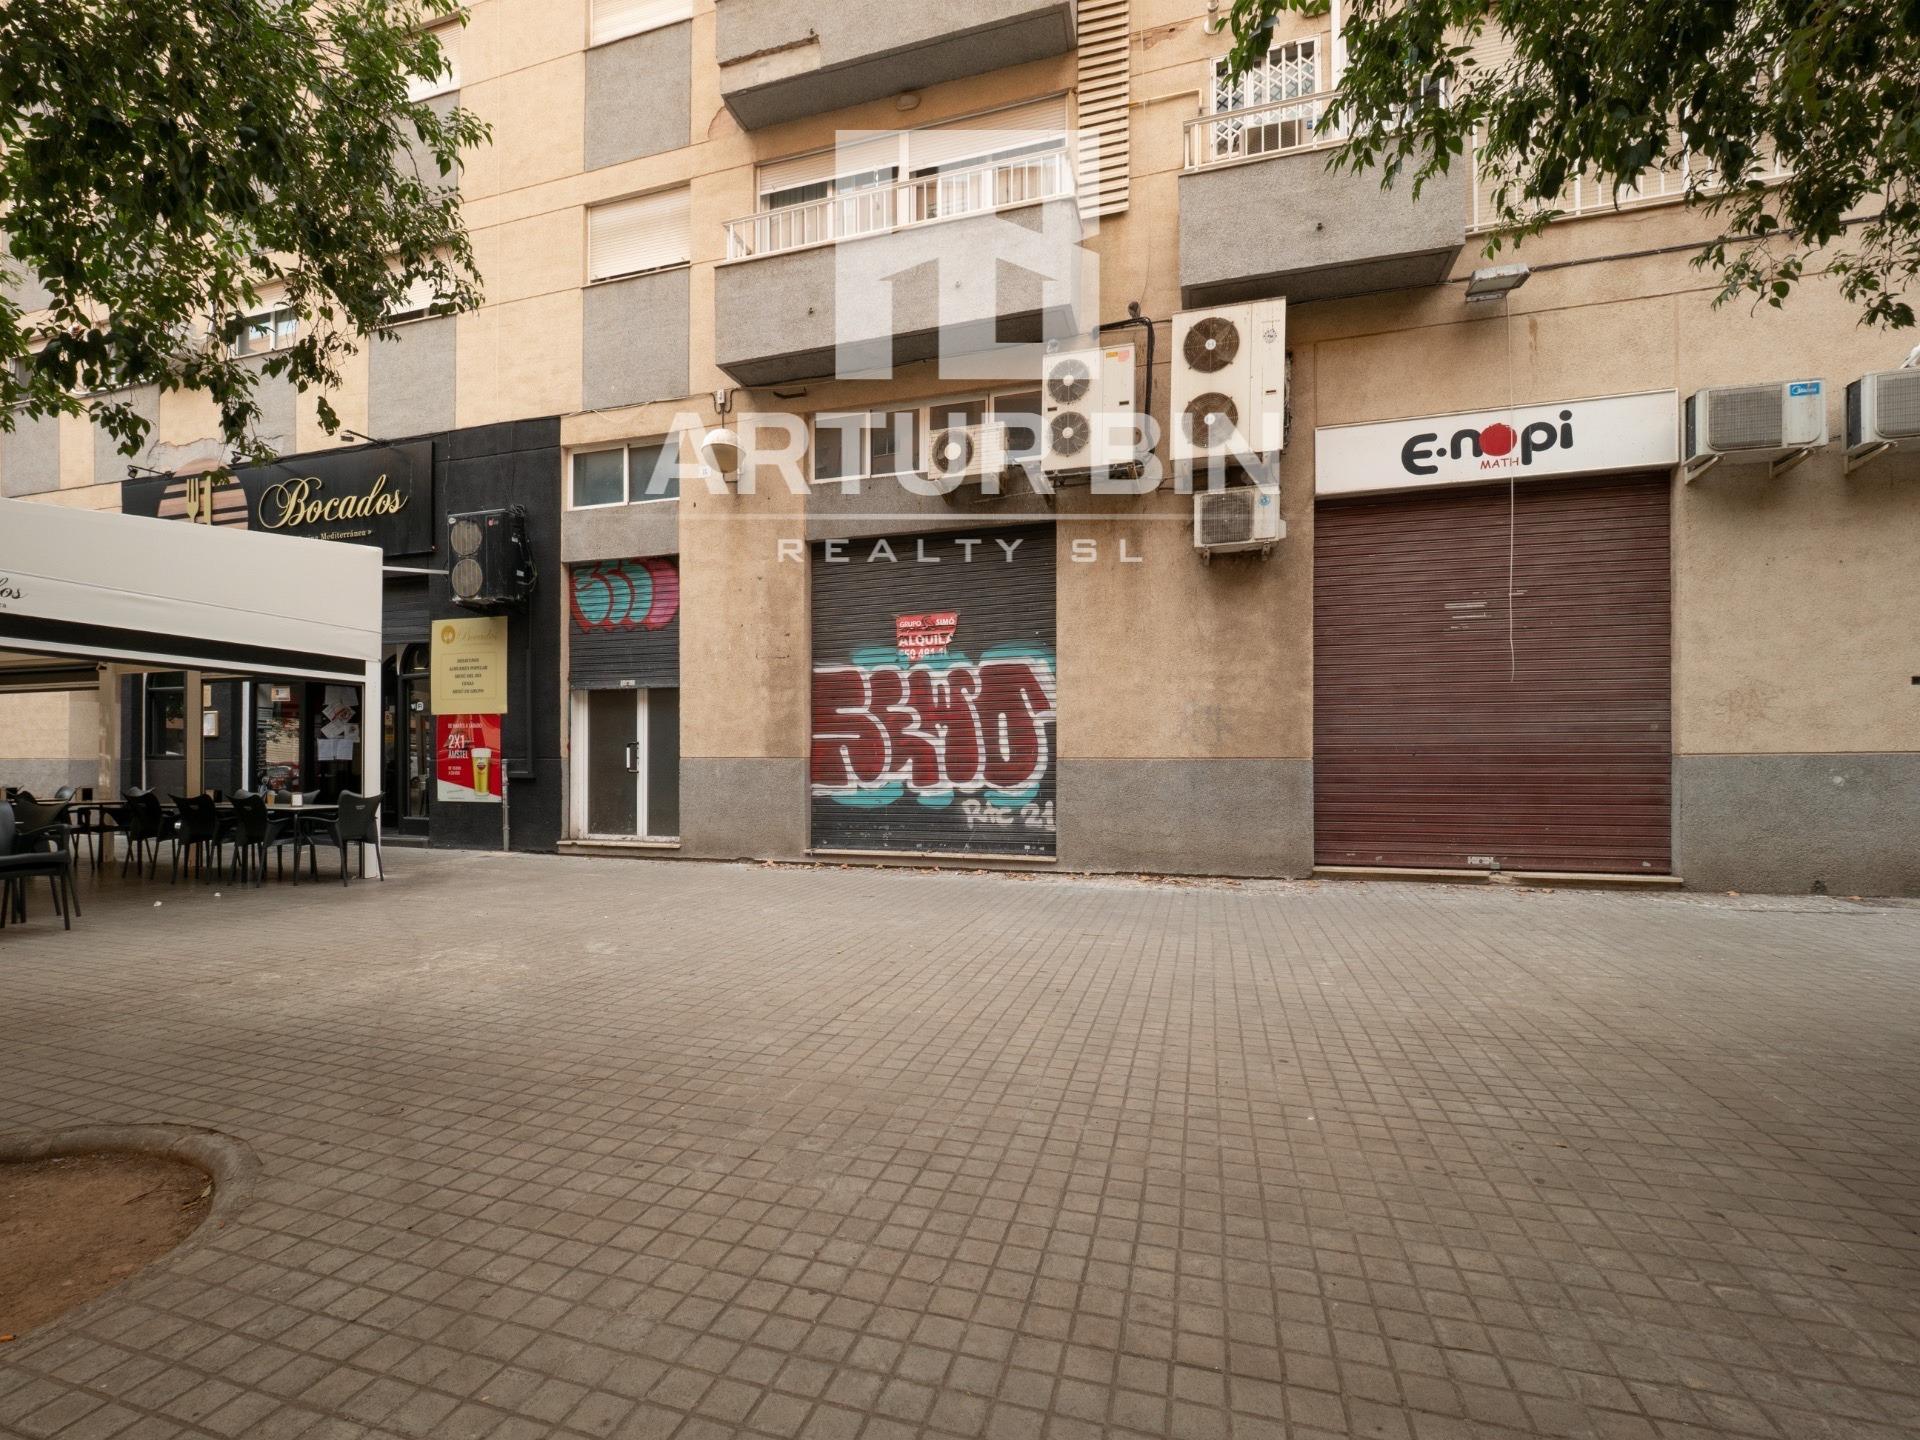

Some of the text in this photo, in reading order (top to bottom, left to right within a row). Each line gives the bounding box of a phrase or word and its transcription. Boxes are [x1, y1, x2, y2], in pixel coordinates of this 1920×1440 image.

[1480, 457, 1519, 470] MATH
[258, 473, 408, 529] Bocados
[899, 616, 955, 628] GRUPO SIMÓ
[447, 749, 470, 759] AMSTEL
